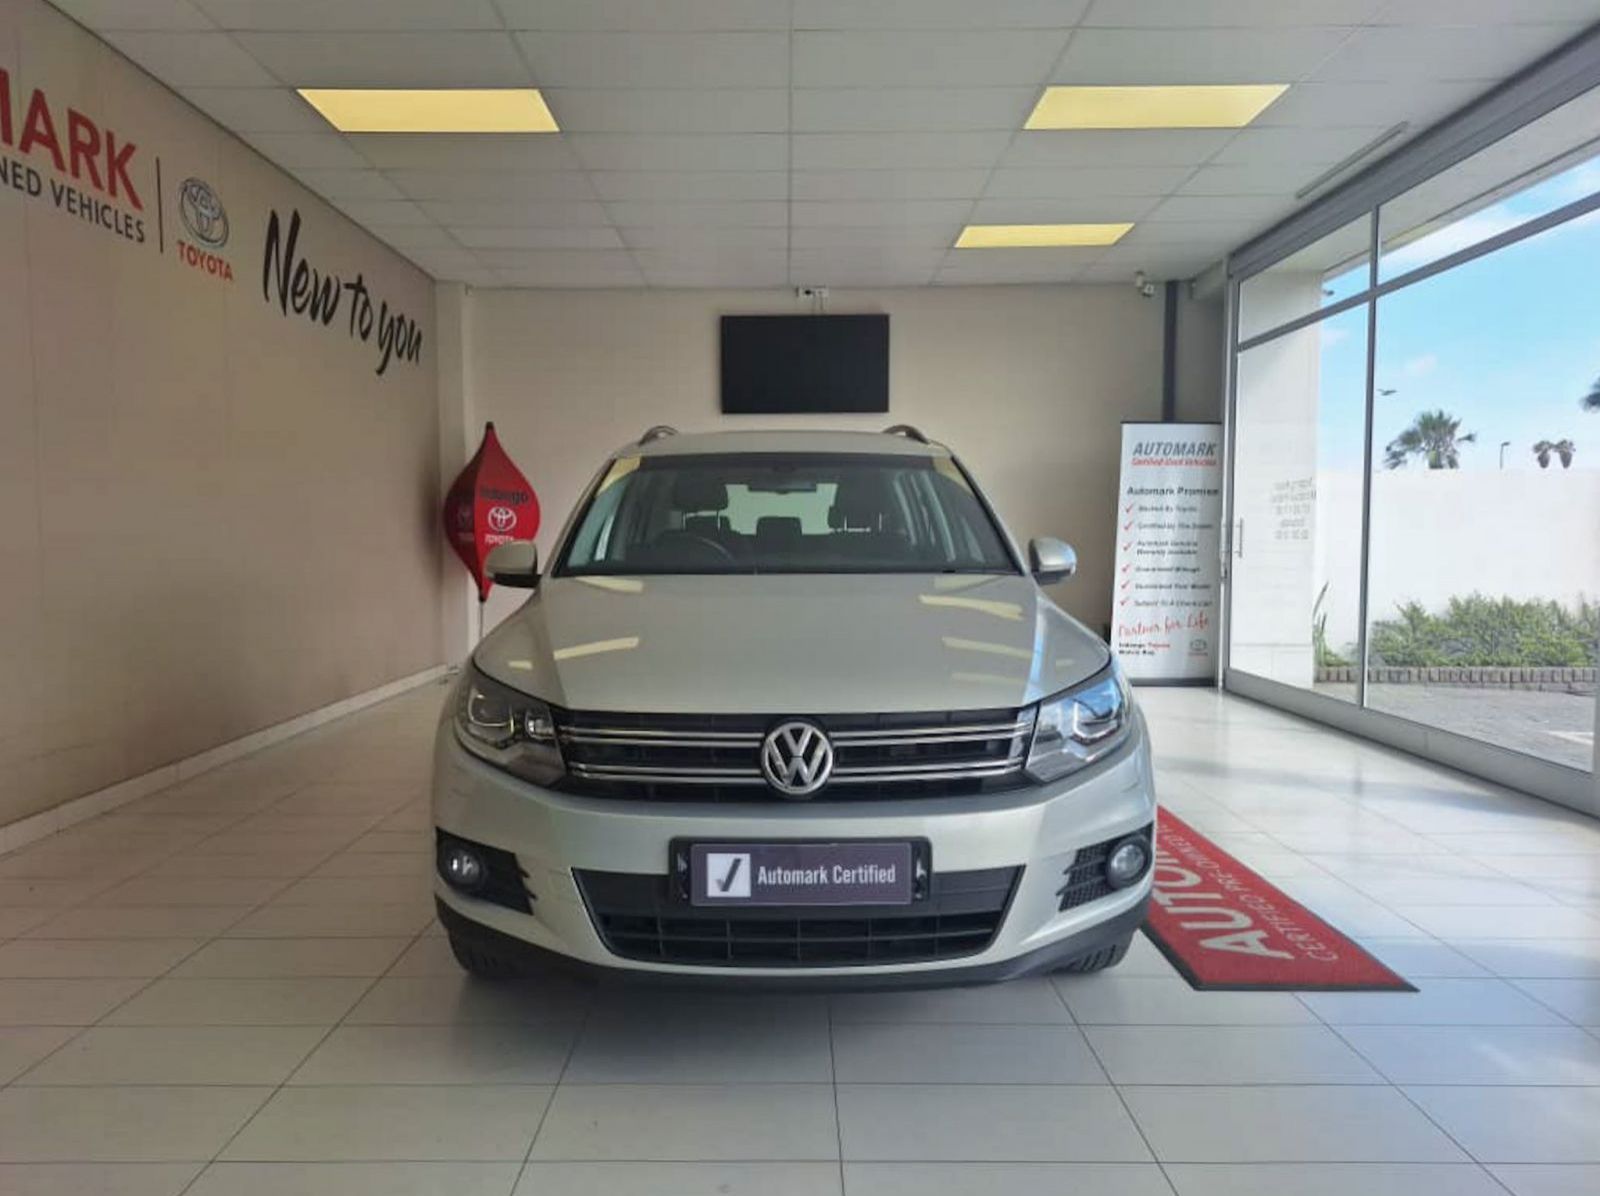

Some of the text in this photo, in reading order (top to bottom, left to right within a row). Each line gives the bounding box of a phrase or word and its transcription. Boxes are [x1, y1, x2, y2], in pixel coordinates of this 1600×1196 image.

[50, 178, 145, 243] VEHICLES
[177, 240, 233, 281] TOYOTA
[263, 209, 422, 376] New to you
[1132, 442, 1218, 456] AUTOMARK
[1127, 486, 1174, 496] Automark
[757, 864, 896, 885] Automark Certified
[1239, 894, 1339, 961] CERTIFIED
